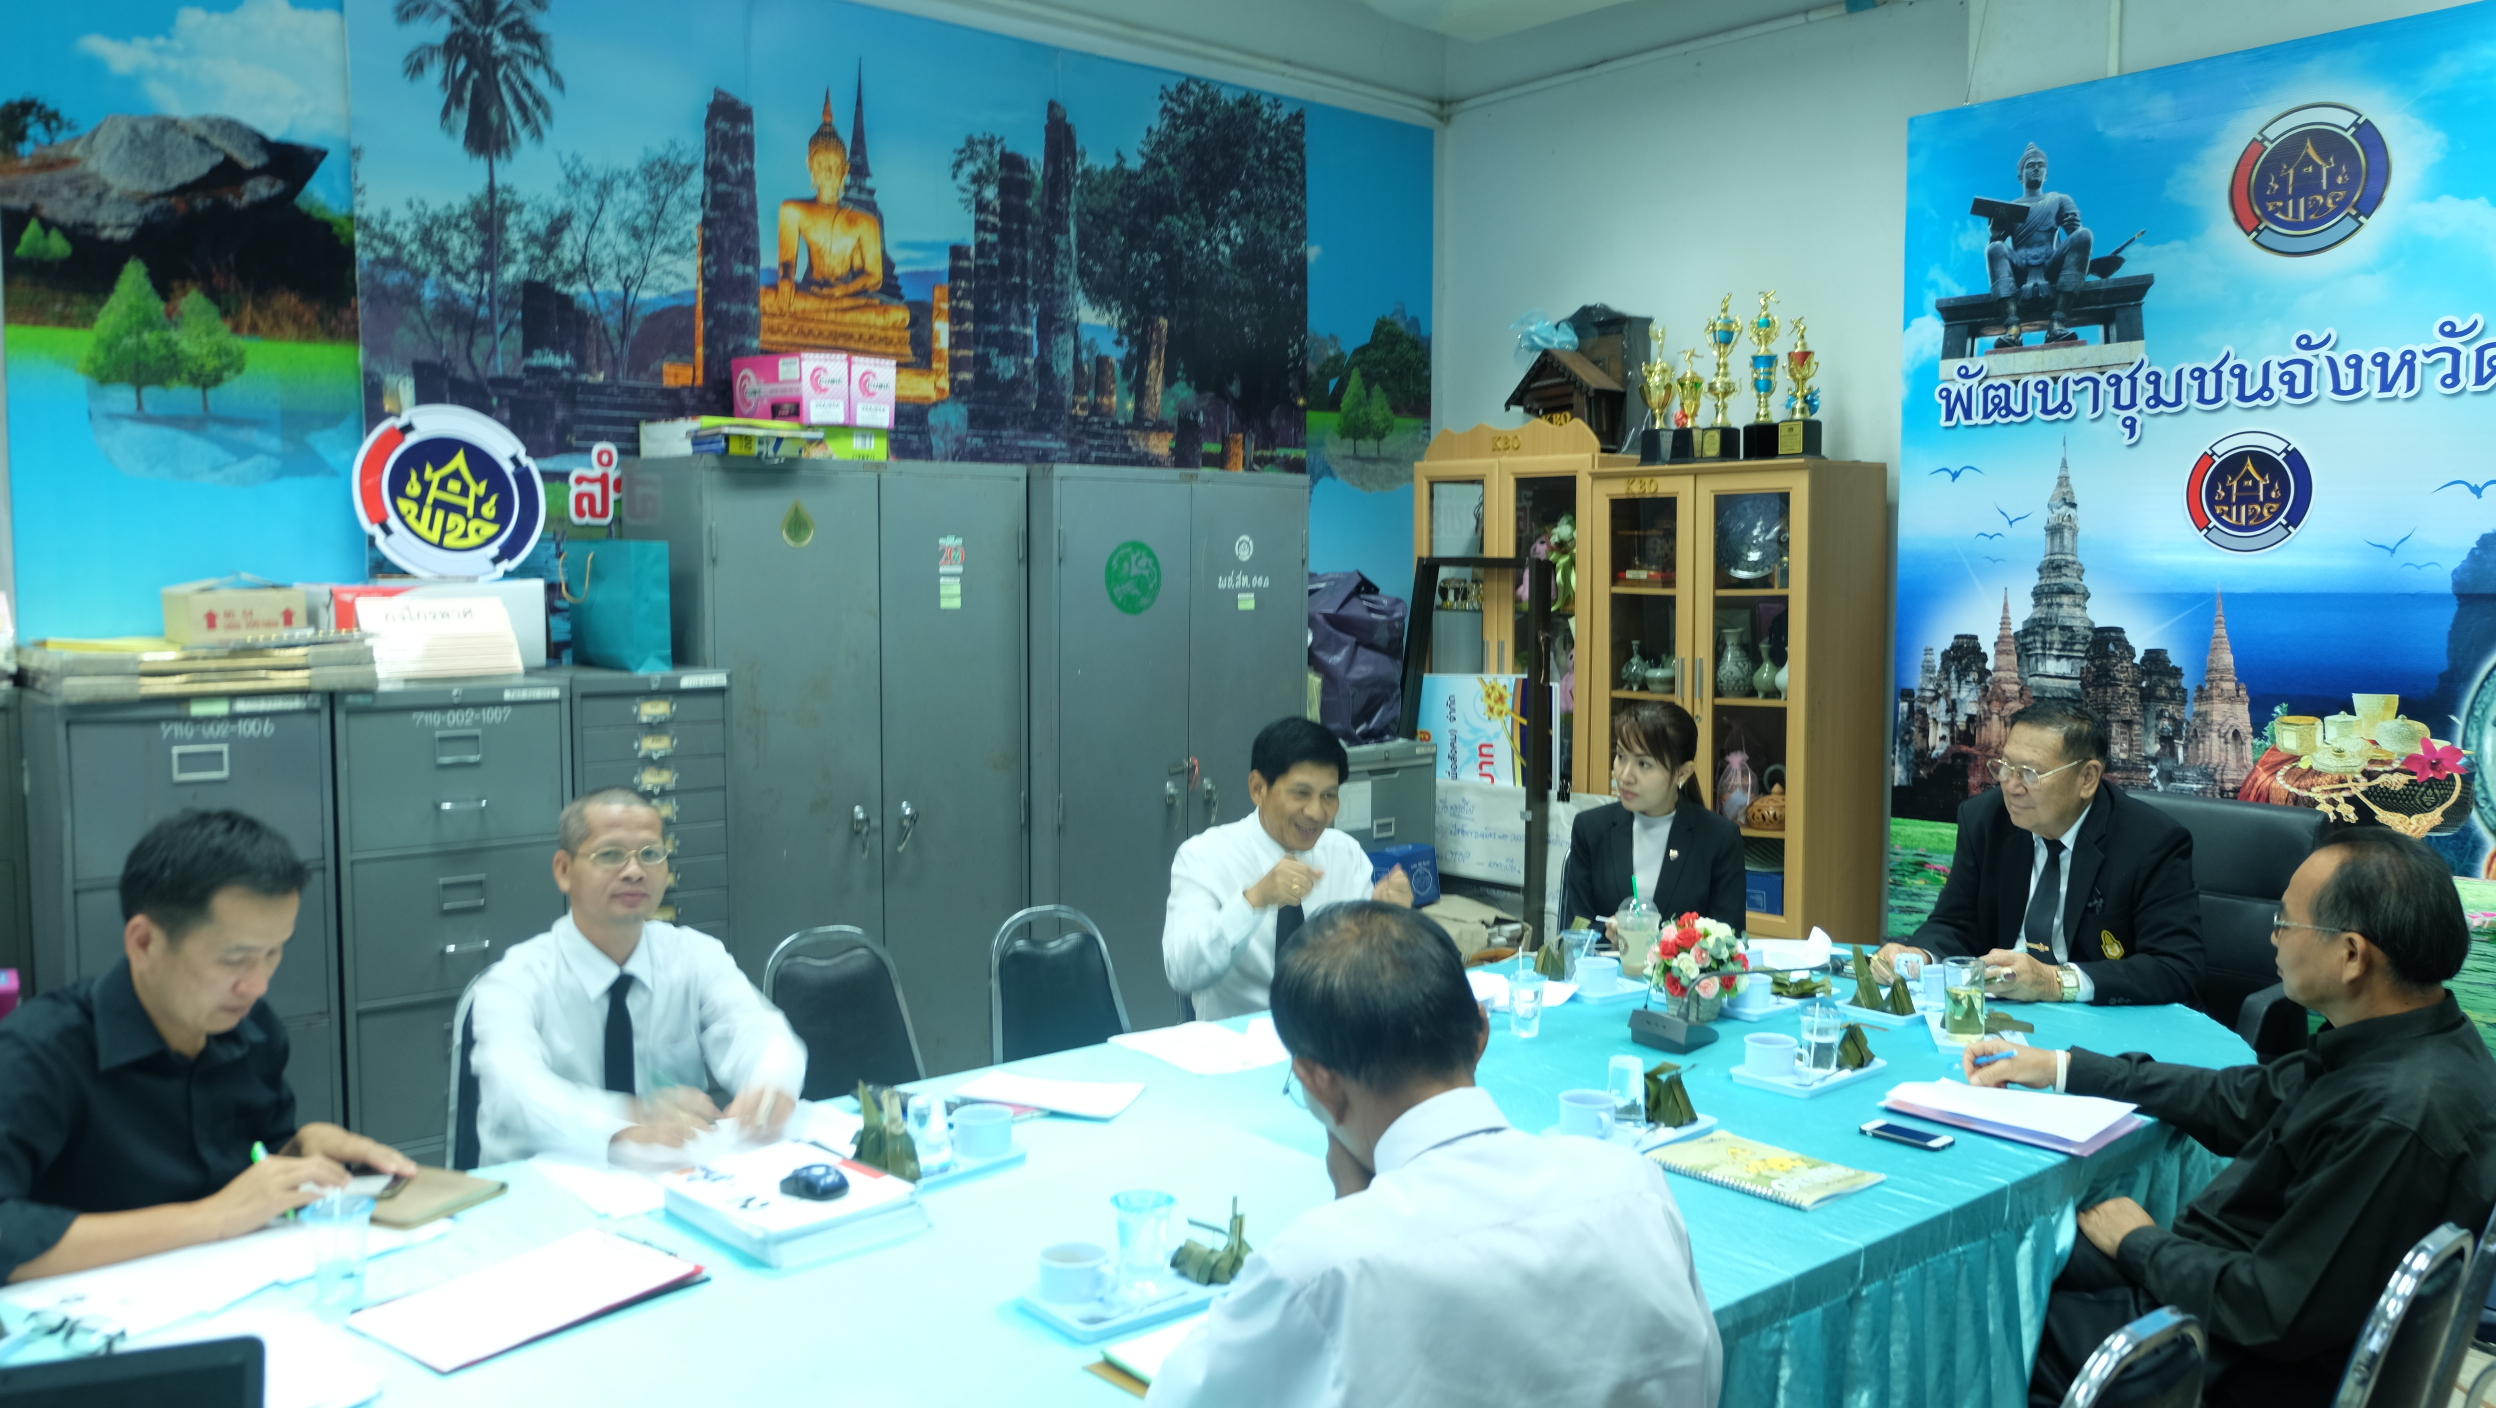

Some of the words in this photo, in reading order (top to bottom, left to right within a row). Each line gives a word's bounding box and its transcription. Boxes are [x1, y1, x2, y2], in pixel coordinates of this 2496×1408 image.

[1491, 434, 1522, 451] KBO
[1624, 477, 1659, 495] KBO
[411, 705, 513, 728] 7110-002-1007
